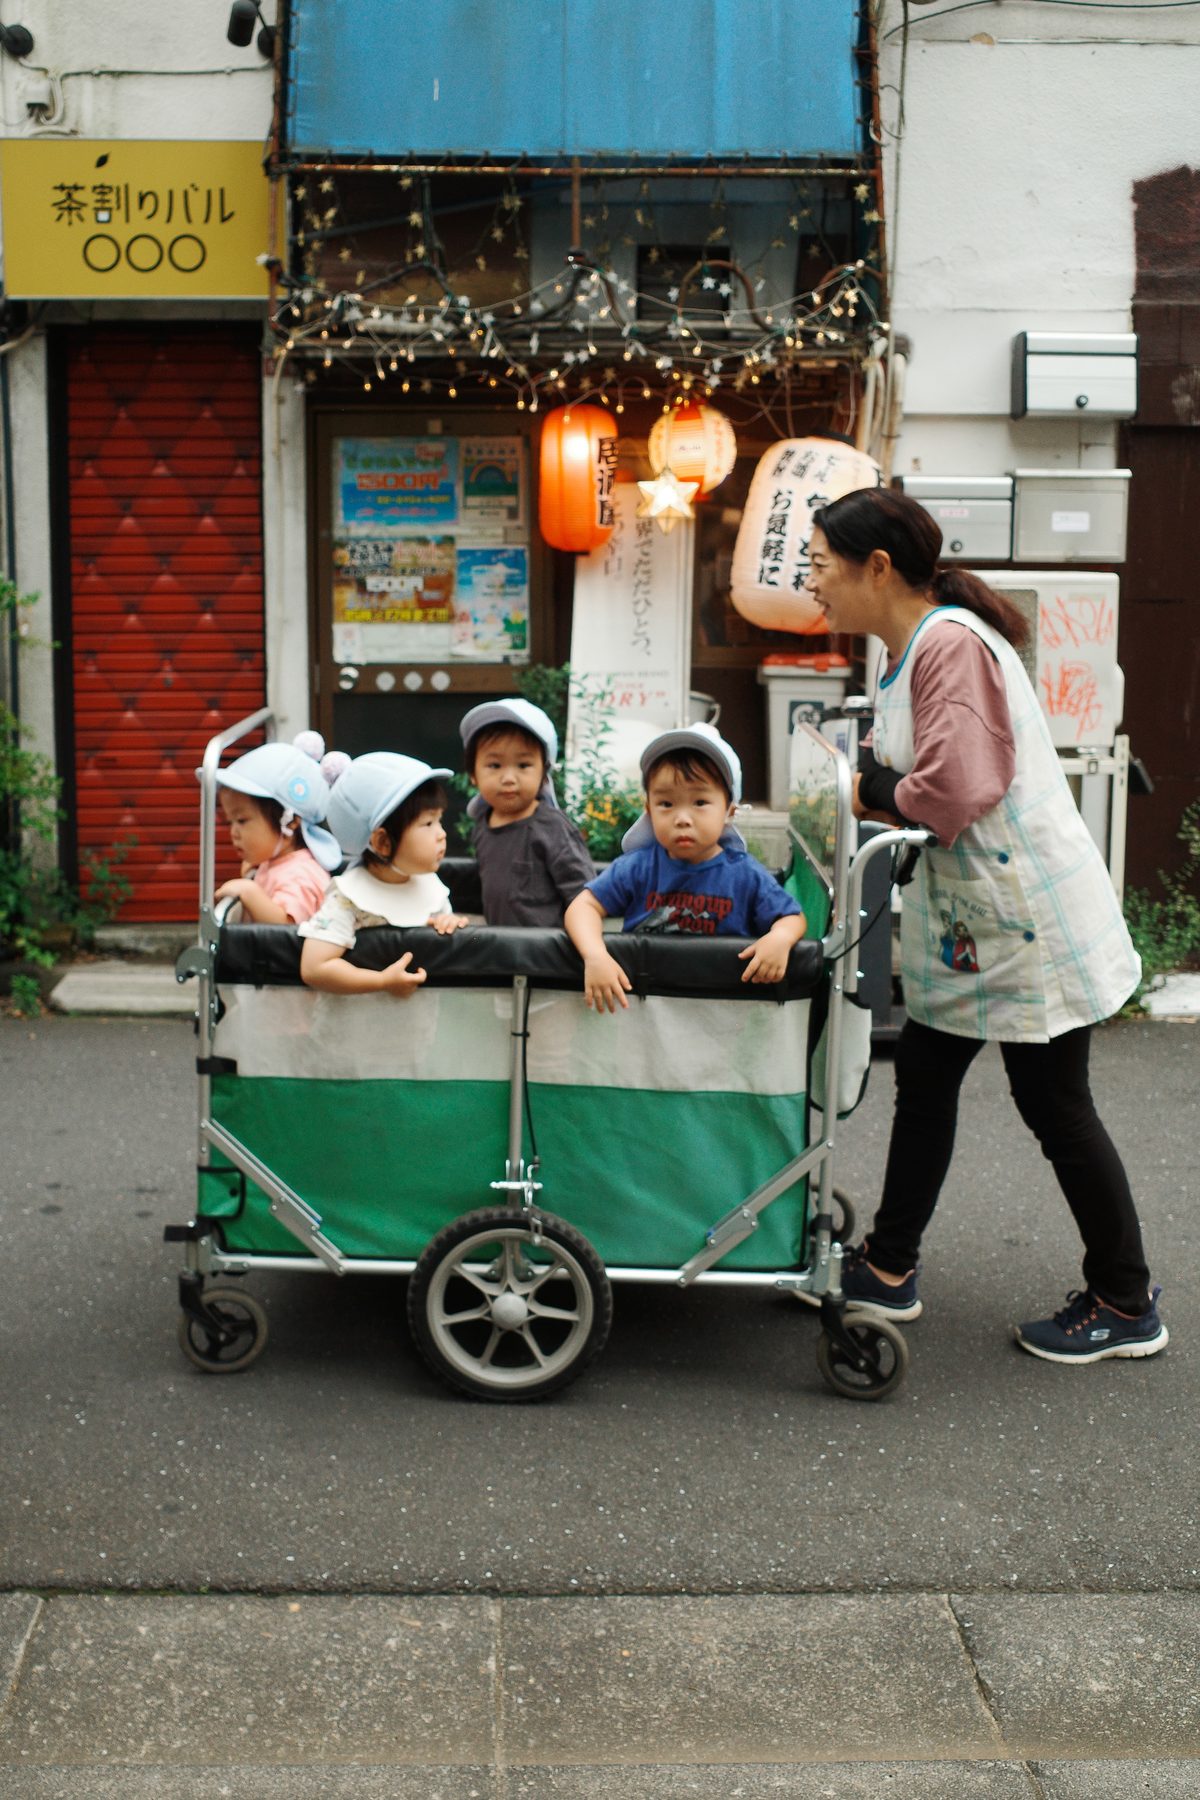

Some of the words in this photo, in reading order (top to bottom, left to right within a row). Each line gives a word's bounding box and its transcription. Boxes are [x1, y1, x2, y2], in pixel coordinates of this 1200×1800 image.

[52, 183, 235, 226] 茶割りバル
